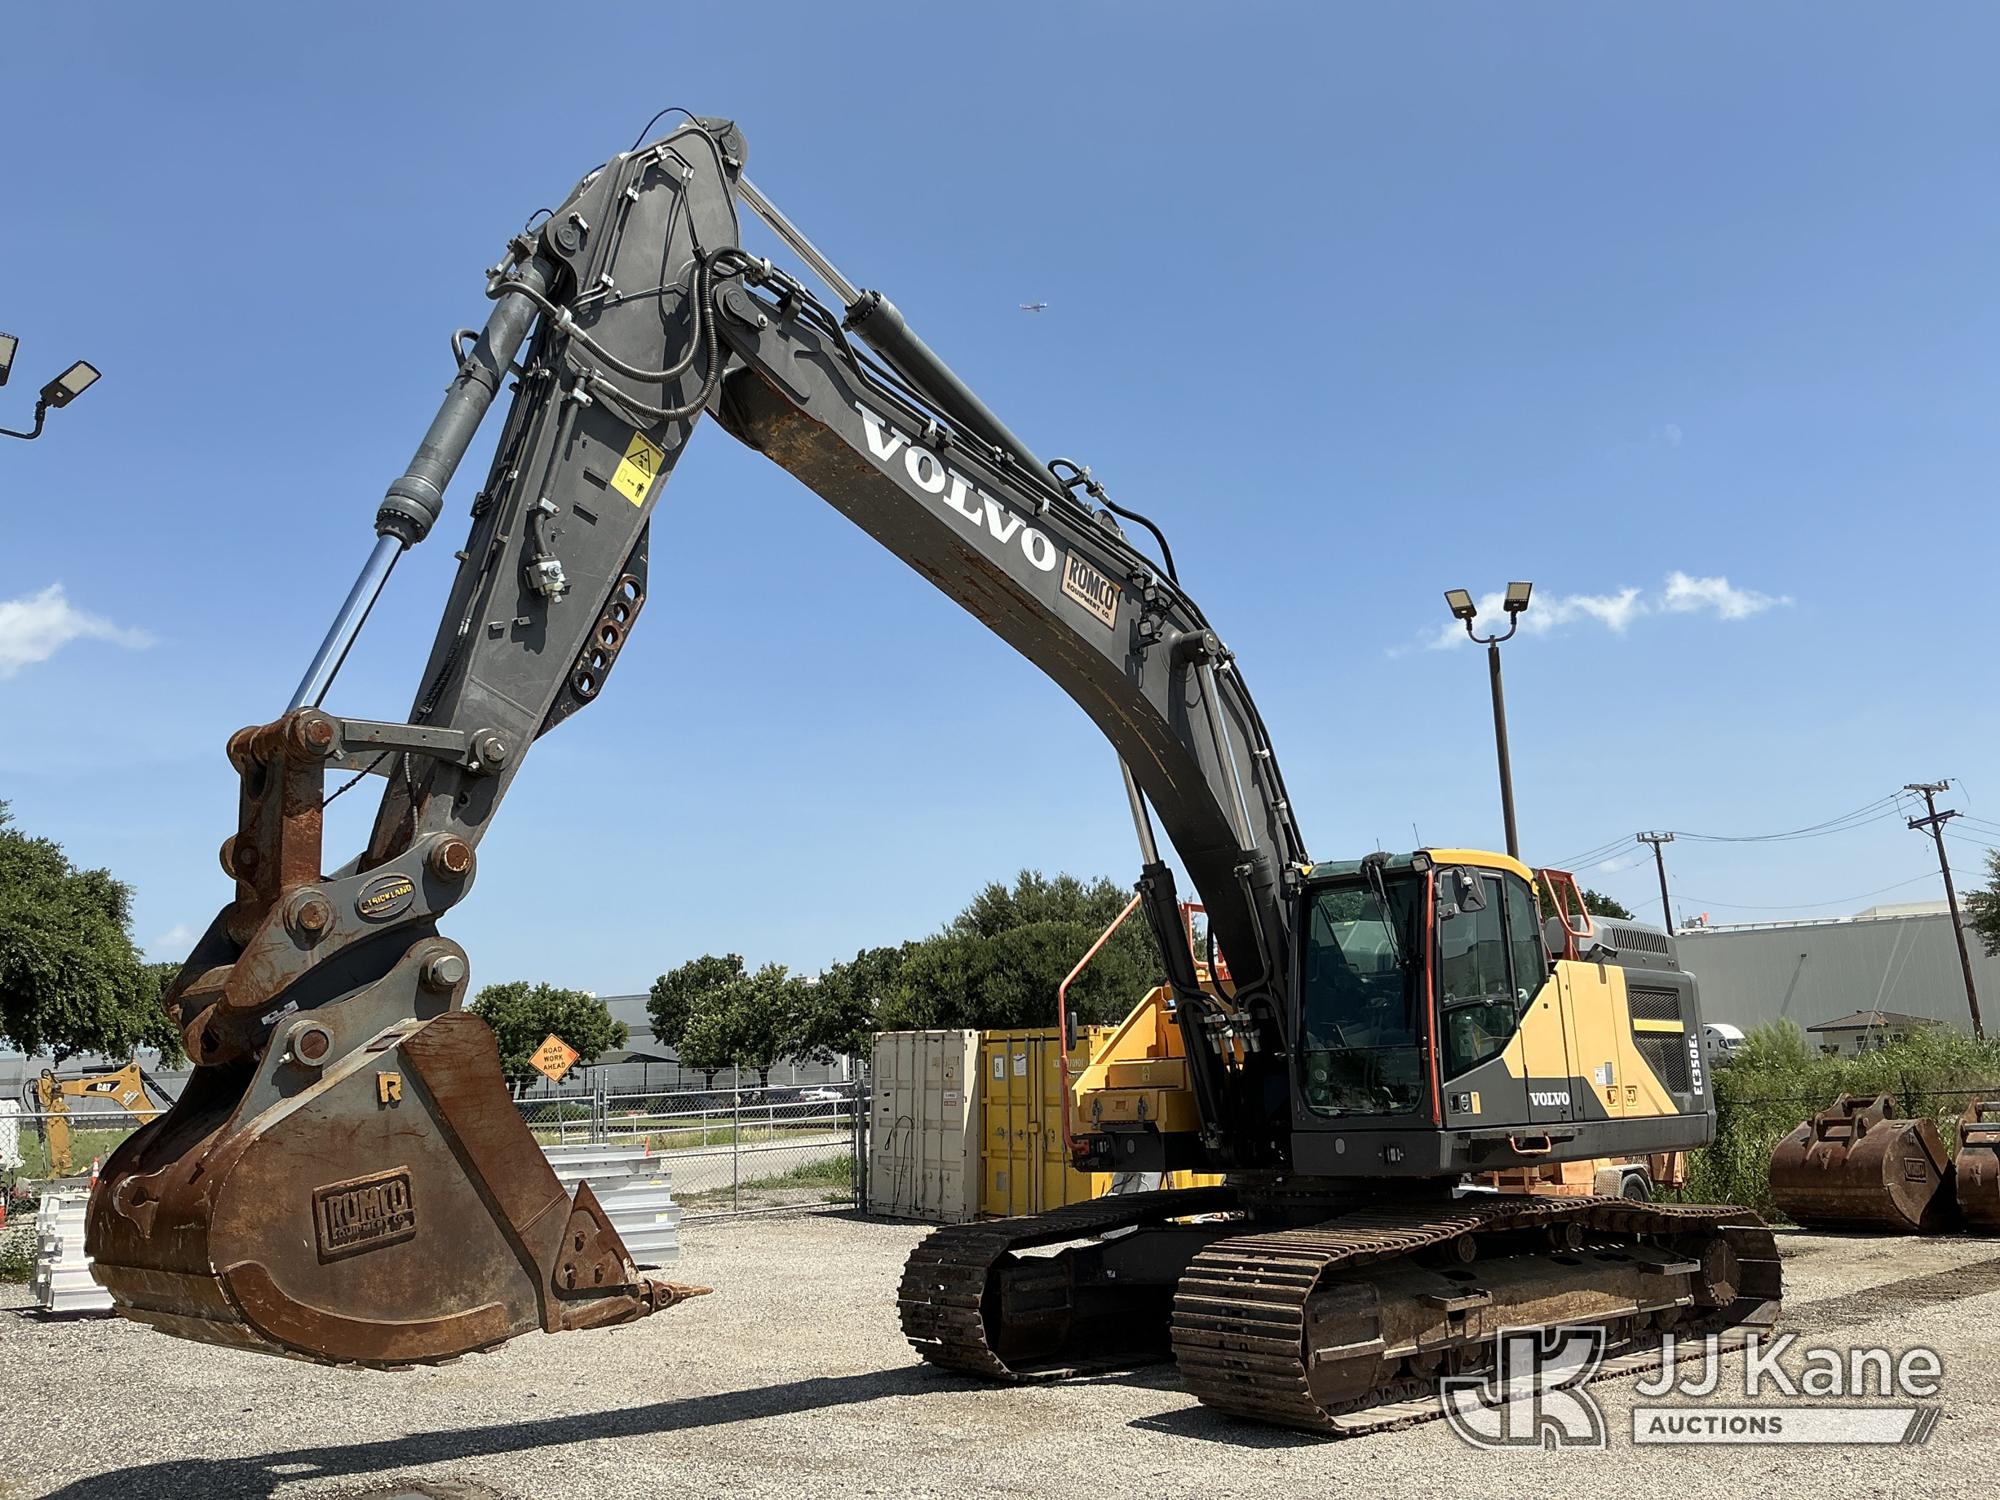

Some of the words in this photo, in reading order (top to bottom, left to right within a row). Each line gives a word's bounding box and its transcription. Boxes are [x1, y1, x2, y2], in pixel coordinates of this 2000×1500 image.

[855, 401, 1057, 572] VOLVO
[1069, 557, 1115, 611] ROMCO
[1066, 582, 1101, 612] EQUIPMENT
[543, 1046, 563, 1054] ROAD
[543, 1054, 564, 1062] WORK
[1688, 1033, 1704, 1096] EC350EL
[543, 1061, 566, 1070] AHEAD
[96, 1083, 112, 1092] CAT
[1529, 1092, 1571, 1106] VOLVO
